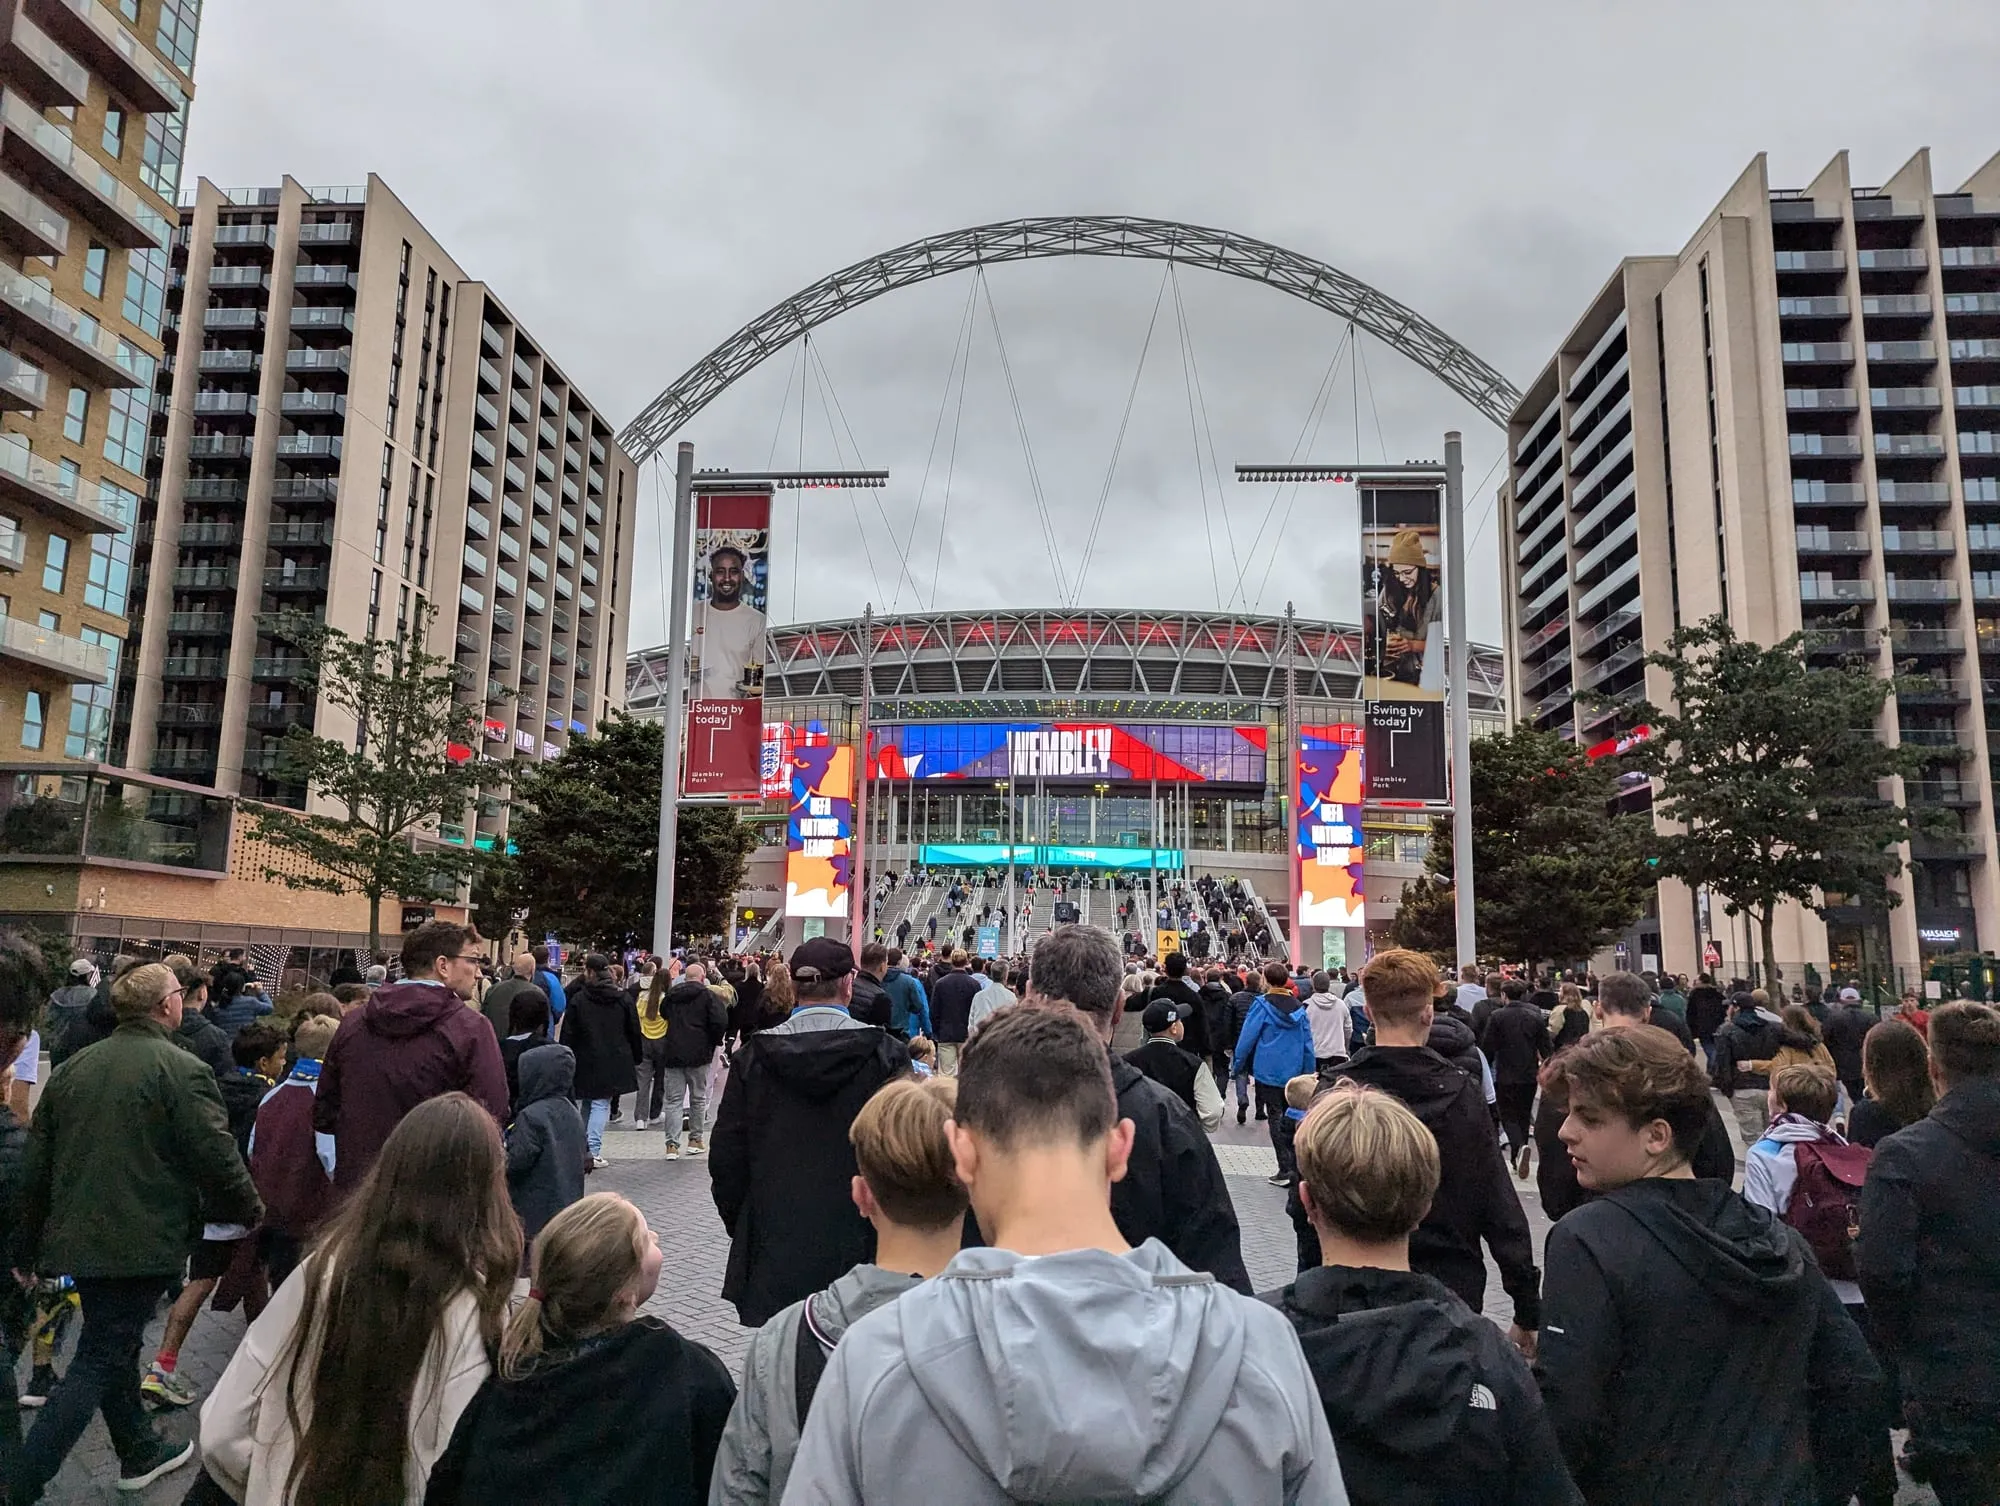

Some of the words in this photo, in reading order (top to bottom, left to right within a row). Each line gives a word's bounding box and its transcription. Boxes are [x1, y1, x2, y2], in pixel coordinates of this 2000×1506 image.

[696, 704, 728, 715] Swing
[731, 705, 744, 715] by
[1373, 706, 1407, 717] Swing
[1410, 706, 1424, 717] by
[694, 716, 727, 725] today
[1373, 717, 1406, 728] today
[1007, 729, 1112, 776] WEMBLEY
